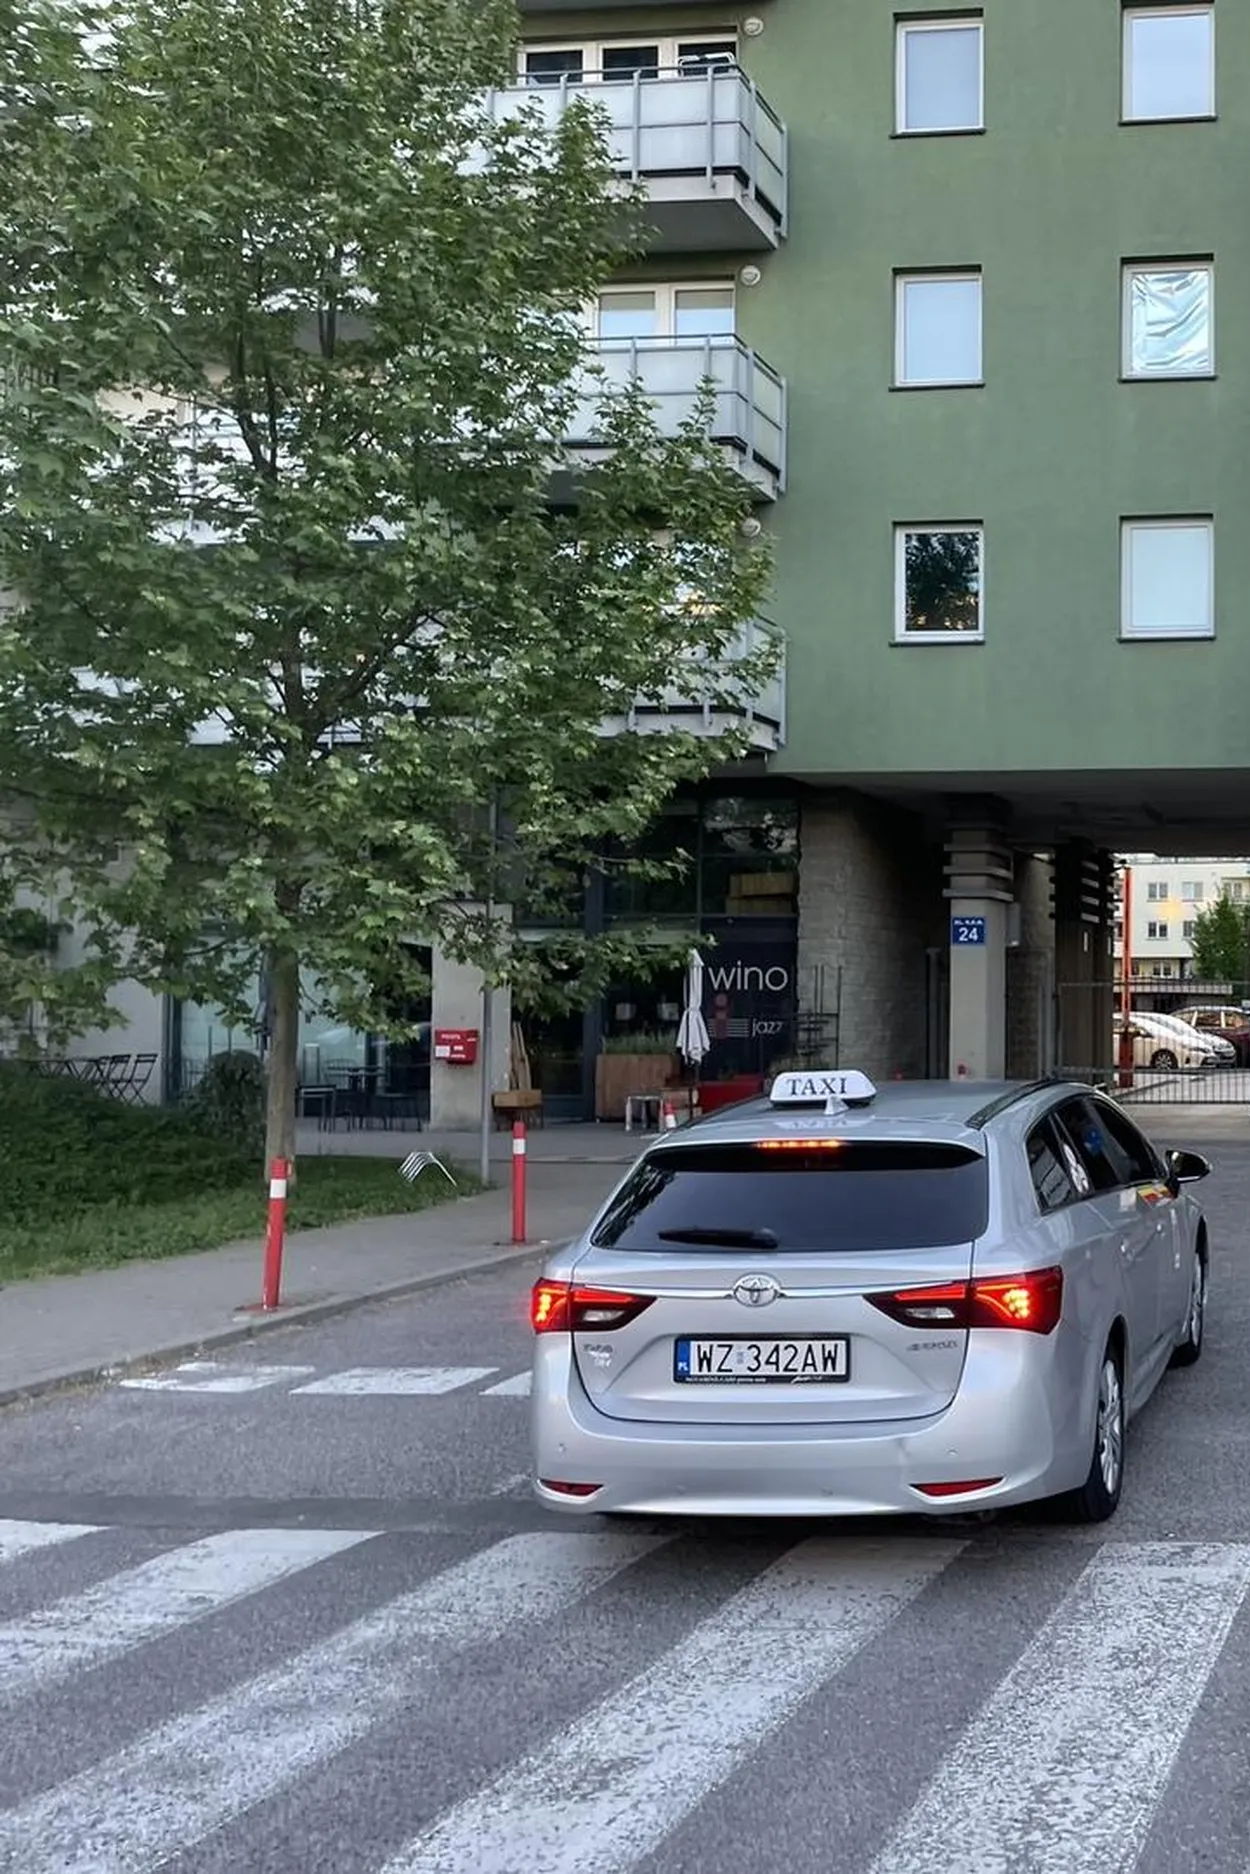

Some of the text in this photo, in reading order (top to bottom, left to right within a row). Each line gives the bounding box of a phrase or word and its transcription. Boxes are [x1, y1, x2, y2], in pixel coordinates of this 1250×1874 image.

[958, 927, 978, 942] 24
[708, 960, 788, 991] wino
[786, 1077, 848, 1096] TAXI
[697, 1344, 733, 1373] WZ
[747, 1344, 838, 1373] 342AW
